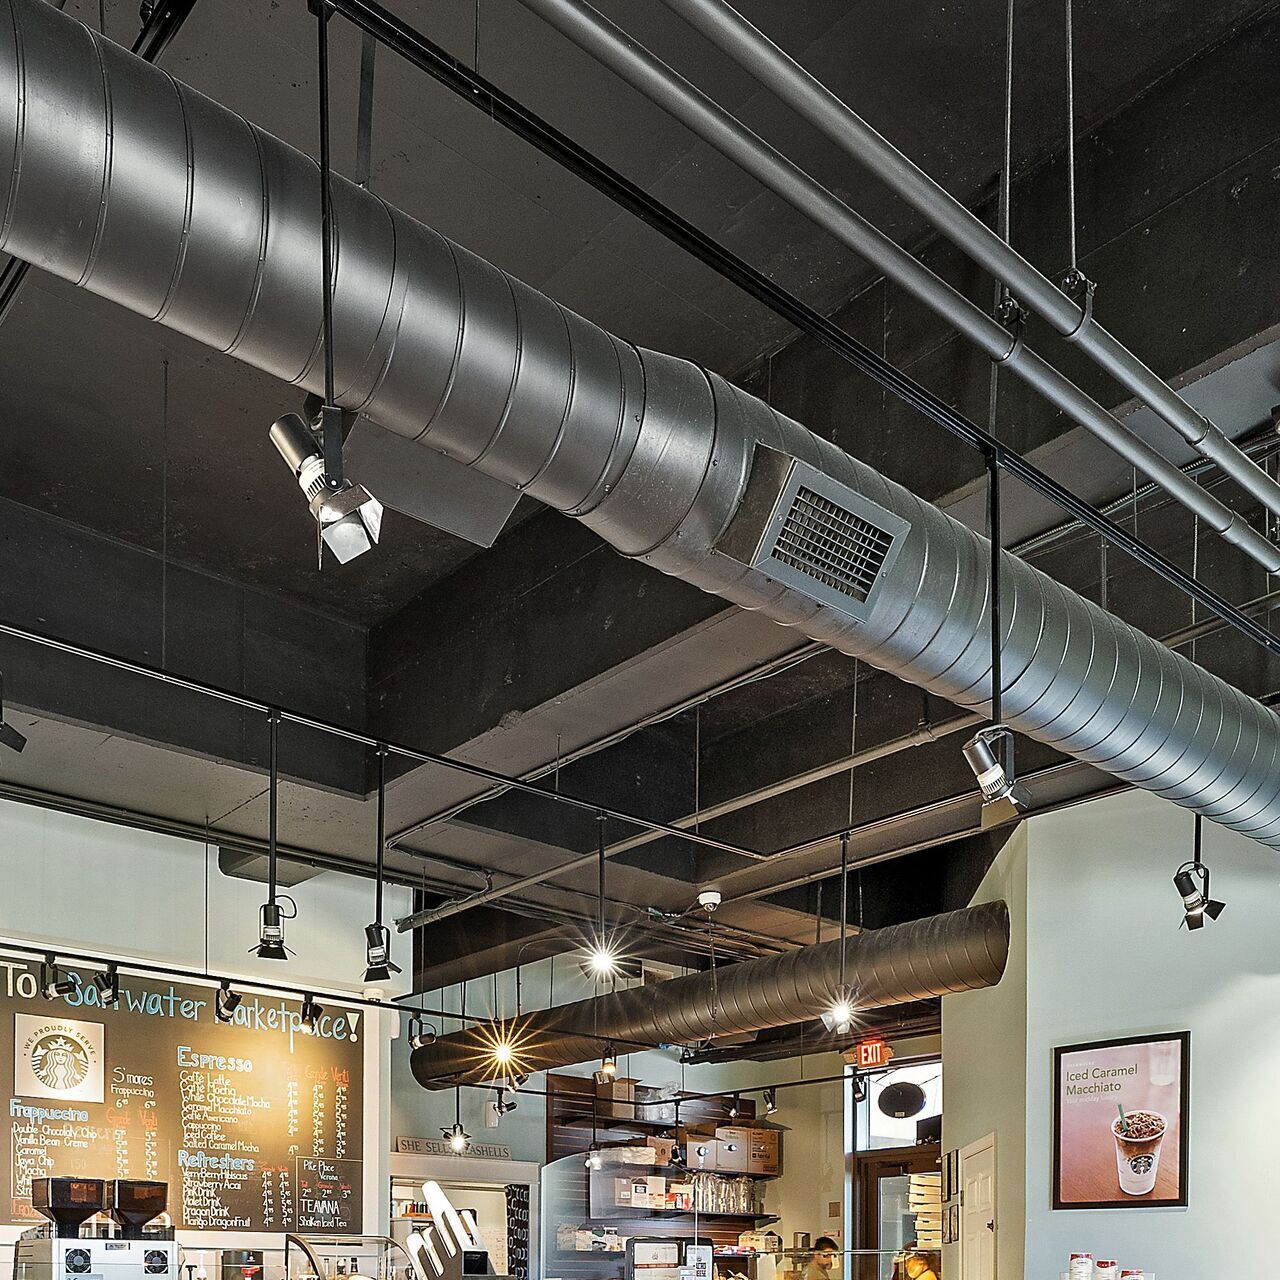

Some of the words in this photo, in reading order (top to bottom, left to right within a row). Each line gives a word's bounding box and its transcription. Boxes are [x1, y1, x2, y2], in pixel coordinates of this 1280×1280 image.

[23, 1038, 33, 1050] WE
[33, 1025, 74, 1038] PROUDLY
[75, 1032, 96, 1055] SERVE
[177, 1045, 253, 1072] Espresso
[861, 1043, 881, 1065] EXIT
[207, 1072, 231, 1086] Latte
[1066, 1069, 1089, 1082] Iced
[1092, 1064, 1138, 1079] Caramel
[110, 1084, 154, 1098] Frappuccino
[207, 1081, 236, 1096] Mocha
[1066, 1082, 1122, 1096] Macchiato
[10, 1098, 88, 1124] Frappuccino
[13, 1122, 38, 1134] Double
[81, 1127, 97, 1142] Chip
[14, 1133, 38, 1144] Vanilla
[40, 1134, 60, 1146] Bean
[15, 1144, 46, 1155] Caramel
[401, 1140, 421, 1152] SHE
[15, 1154, 34, 1167] Java
[38, 1156, 55, 1170] Chip
[177, 1149, 256, 1171] Refreshers
[20, 1164, 46, 1176] Mocha
[300, 1199, 340, 1215] TEAVANA
[335, 1217, 347, 1227] Tea
